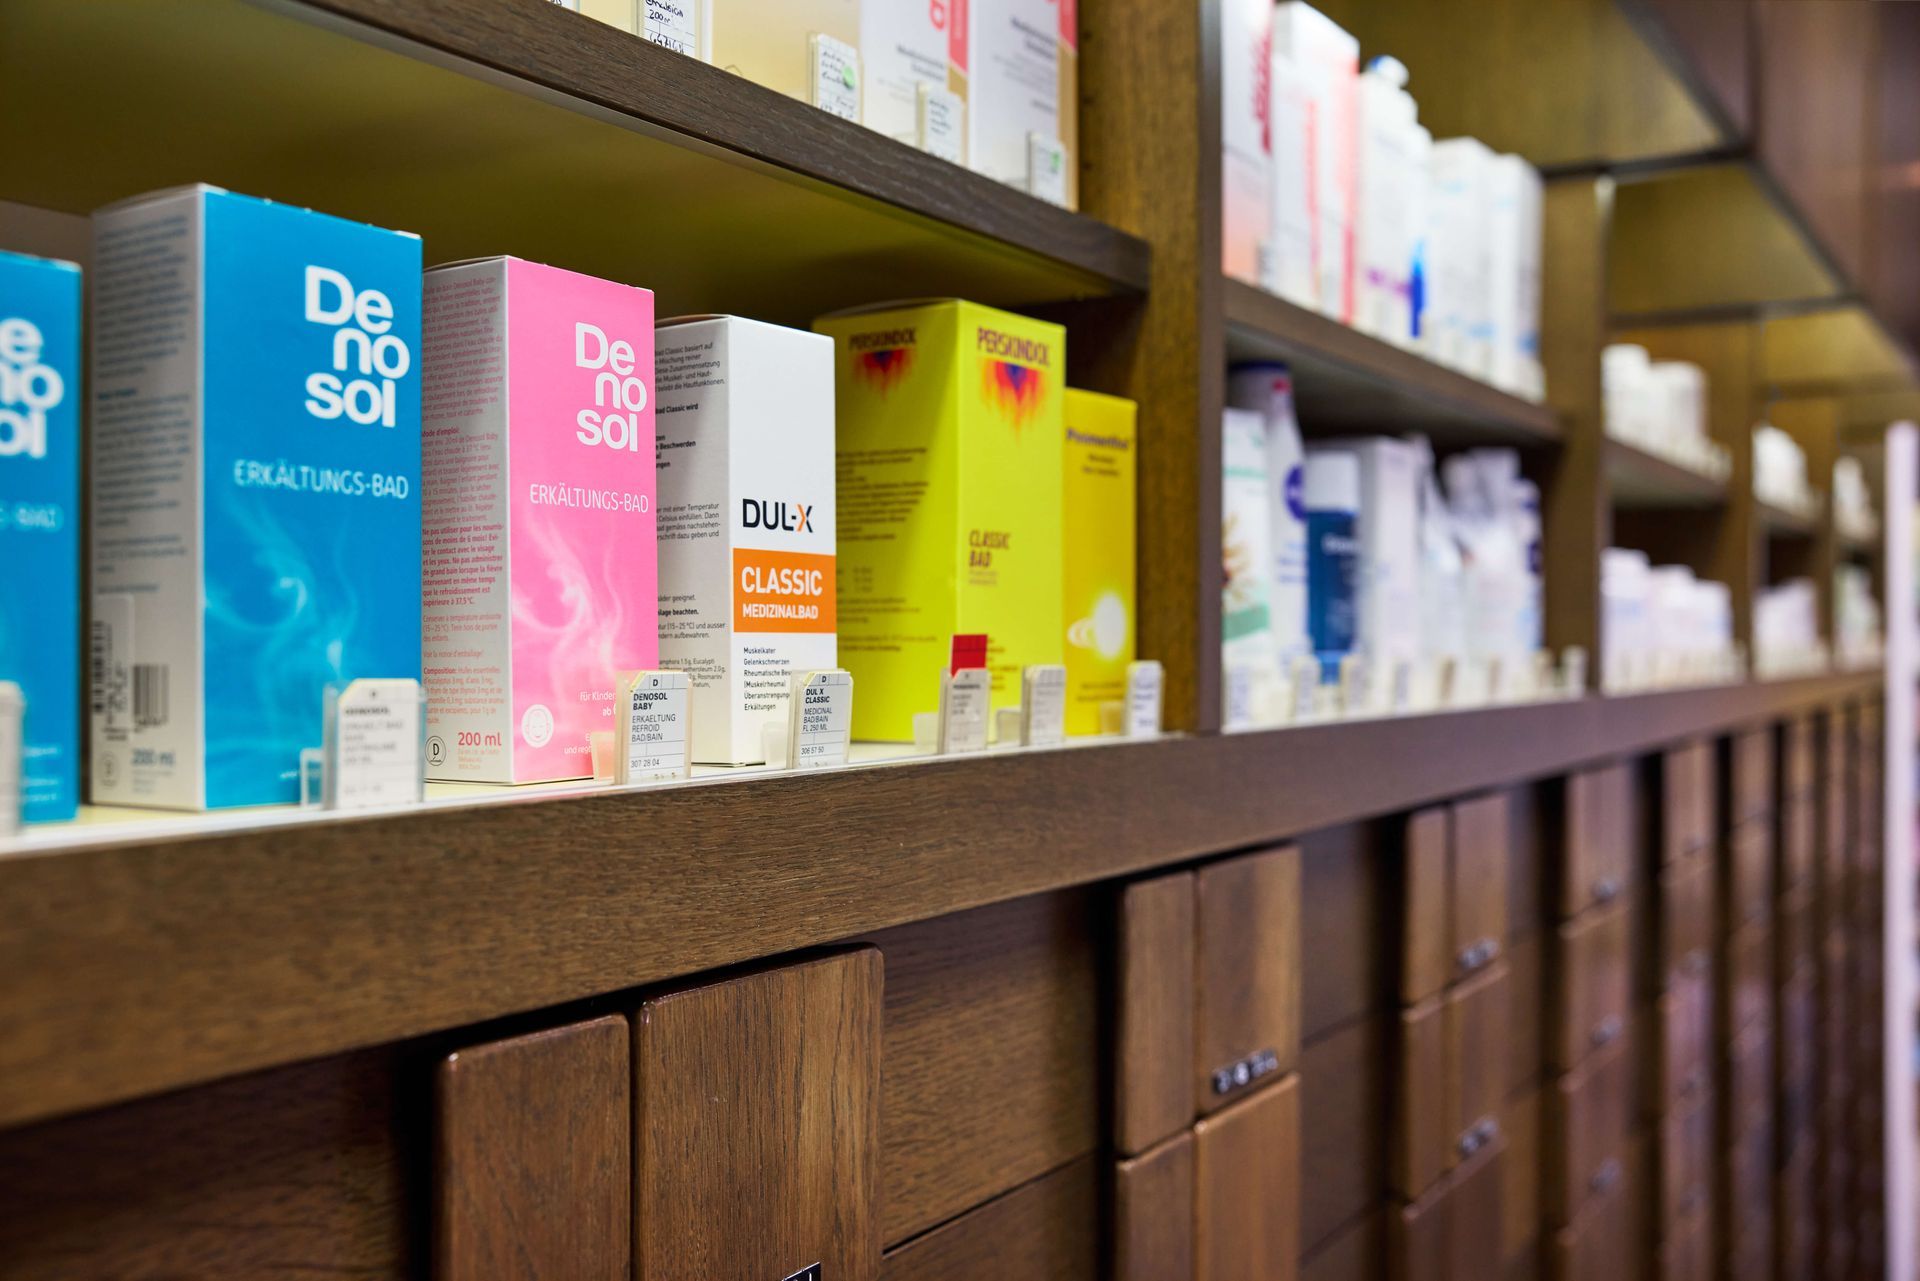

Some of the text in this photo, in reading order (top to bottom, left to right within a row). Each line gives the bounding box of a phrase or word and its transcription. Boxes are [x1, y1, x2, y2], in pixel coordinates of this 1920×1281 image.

[305, 265, 394, 334] De
[576, 322, 636, 376] De
[704, 342, 713, 350] auf
[333, 327, 410, 379] no
[669, 360, 721, 373] Zusammensetzung
[595, 372, 648, 412] no
[305, 372, 396, 428] sol
[576, 409, 638, 452] sol
[660, 441, 696, 449] Beschwerden
[234, 459, 409, 501] ERKÄLTUNGS-BAD
[530, 483, 649, 513] ERKÄLTUNGS-BAD
[688, 503, 719, 511] Temperatur
[742, 498, 814, 534] DUL-X
[687, 521, 720, 529] nachstehen-
[460, 526, 472, 534] pour
[691, 531, 707, 539] geben
[968, 530, 1010, 549] CLASSIC
[968, 550, 992, 568] BAD
[741, 566, 823, 597] CLASSIC
[440, 586, 480, 595] refroidissement
[671, 594, 696, 602] geeignet.
[742, 603, 818, 620] MEDIZINALBAD
[706, 621, 726, 629] ausser
[674, 631, 710, 640] aufbewahren.
[743, 658, 790, 666] Gelenkschmerzen
[652, 679, 659, 687] D
[821, 675, 827, 683] D
[805, 688, 818, 696] DUL
[633, 692, 668, 702] DENOSOL
[805, 696, 831, 704] CLASSIC
[633, 702, 653, 711] BABY
[744, 703, 776, 711] Erkältungen
[804, 707, 832, 715] MEDICINAL
[632, 713, 676, 724] ERKAELTUNG
[631, 724, 660, 732] REFROID
[803, 724, 810, 732] FL
[458, 731, 502, 746] 200 ml
[631, 758, 660, 768] 307 28 04
